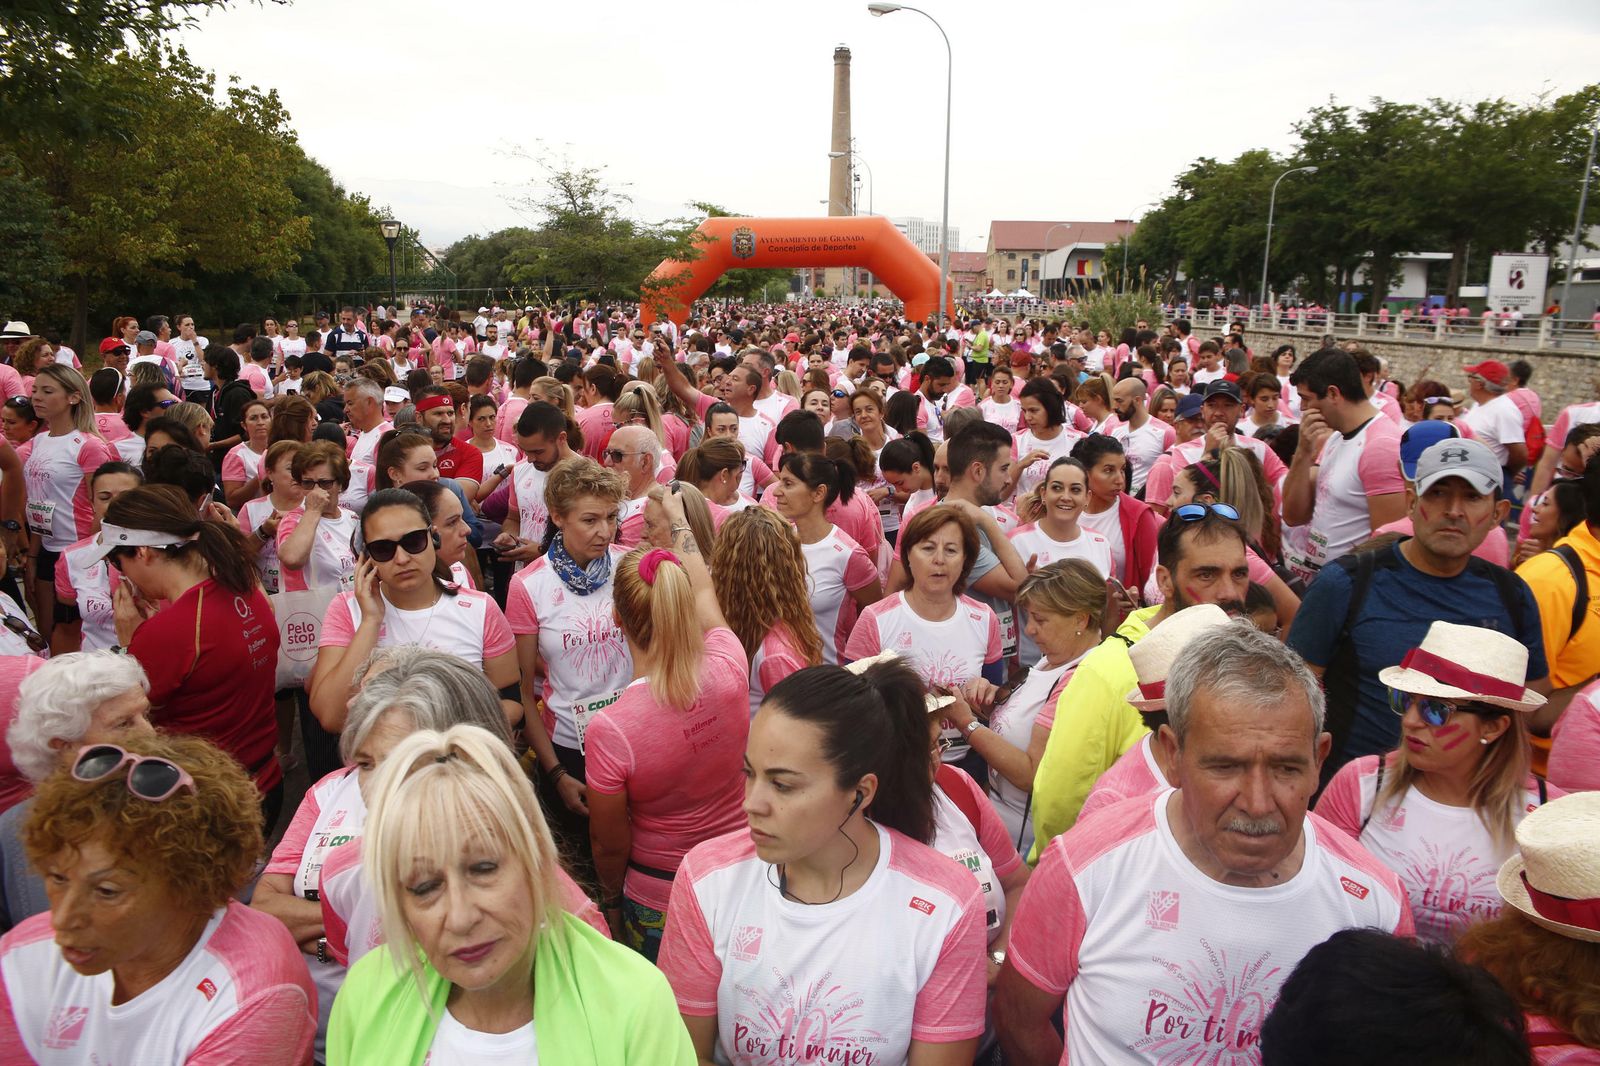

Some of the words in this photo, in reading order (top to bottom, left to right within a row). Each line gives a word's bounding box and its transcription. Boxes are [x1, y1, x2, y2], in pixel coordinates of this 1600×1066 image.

[760, 236, 816, 244] AYUNTAMIENTO
[830, 234, 865, 242] GRANADA
[811, 243, 821, 252] de
[823, 243, 857, 252] Deportes
[287, 621, 315, 635] Pelo
[287, 632, 316, 646] stop
[562, 632, 584, 650] Por
[1449, 897, 1500, 921] muje
[1200, 937, 1219, 969] contigo
[1247, 950, 1272, 982] solidarios
[1171, 998, 1195, 1014] mujer
[1145, 998, 1197, 1040] Por
[733, 1022, 772, 1057] Por
[805, 1041, 879, 1066] mujer
